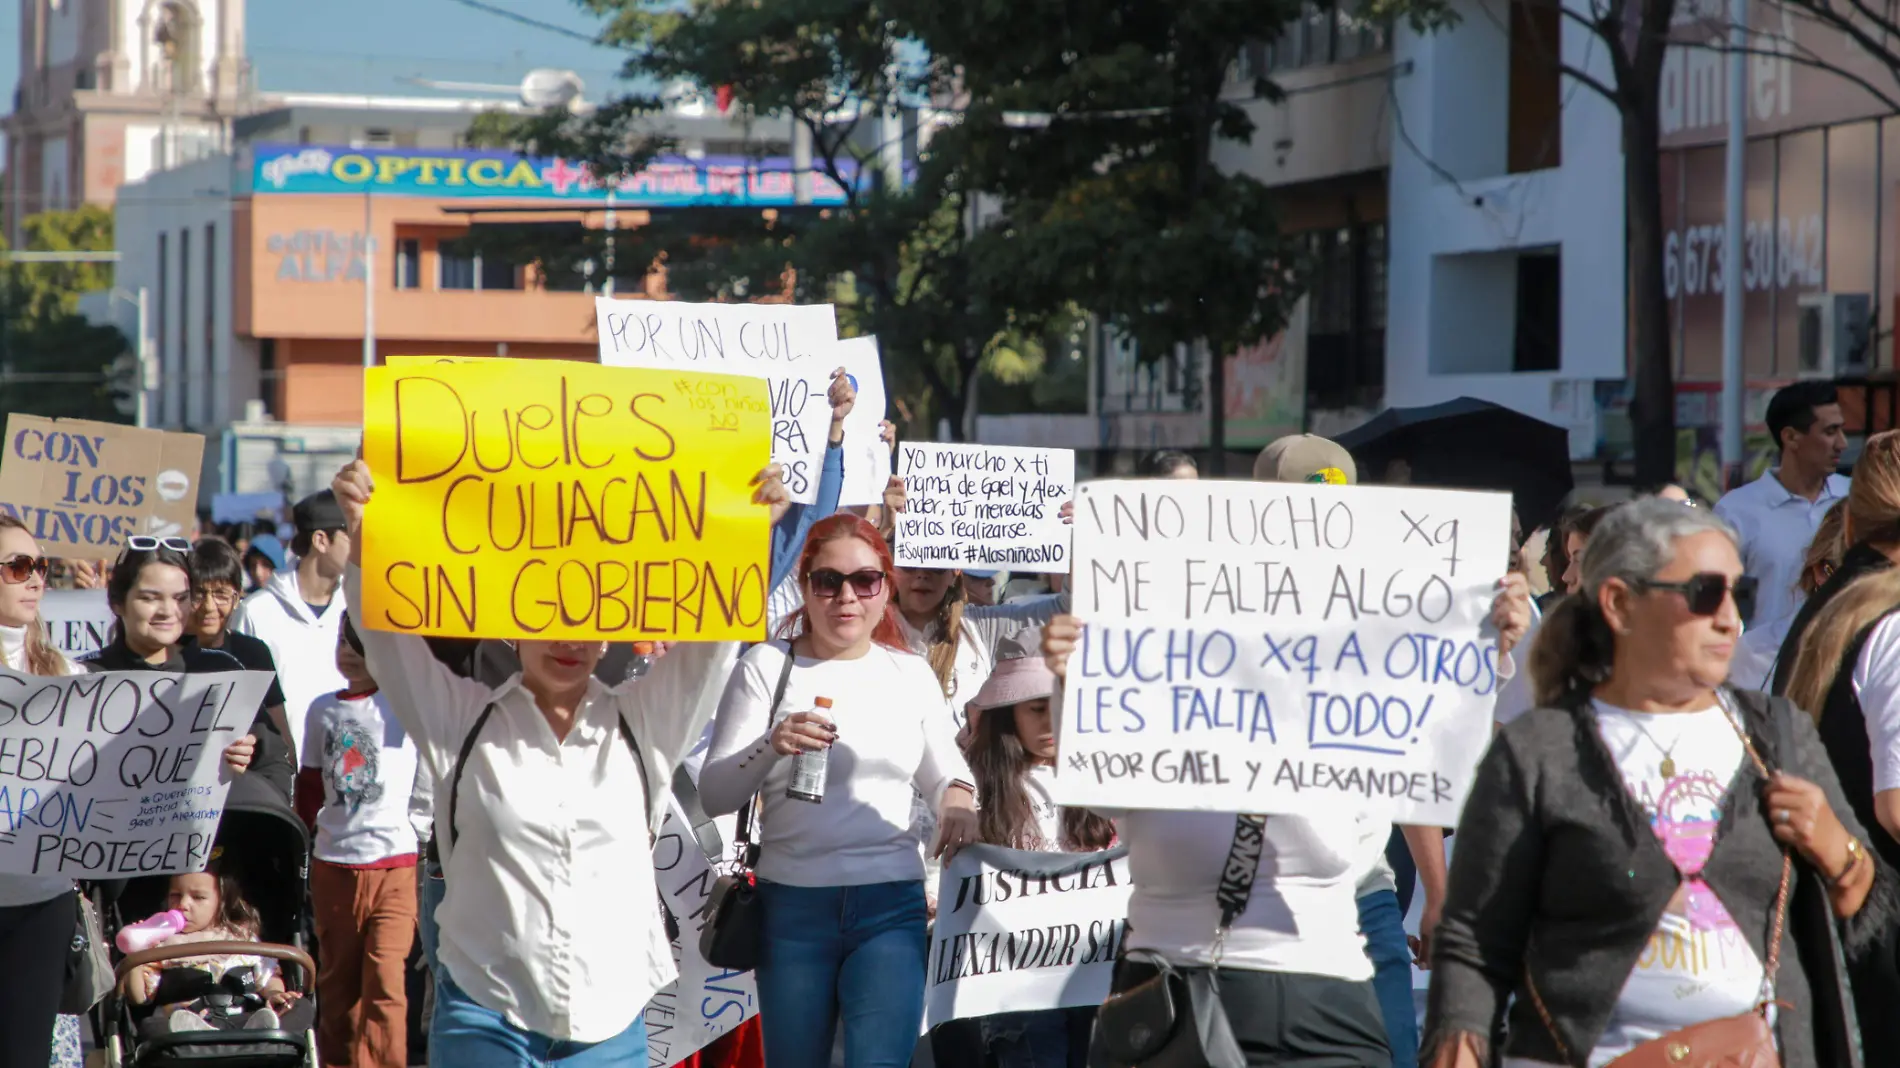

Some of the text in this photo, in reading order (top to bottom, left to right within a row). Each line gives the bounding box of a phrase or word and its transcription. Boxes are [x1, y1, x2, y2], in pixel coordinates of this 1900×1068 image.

[332, 154, 543, 188] OPTICA
[277, 253, 368, 282] ALFA
[608, 313, 811, 361] POR UN CUL.
[395, 375, 676, 484] Dueles
[709, 412, 739, 431] NO
[772, 420, 809, 454] RA
[14, 428, 105, 468] CON
[937, 450, 1006, 473] marcho
[1030, 454, 1048, 475] ti
[62, 470, 146, 507] LOS
[775, 458, 808, 494] OS
[958, 474, 977, 496] de
[442, 470, 706, 554] CULIACAN
[900, 518, 1033, 540] verlos realizarse.
[975, 501, 1046, 520] merecías
[385, 557, 766, 635] SIN GOBIERNO
[1091, 558, 1453, 624] ME FALTA ALGO
[1082, 623, 1237, 683] LUCHO
[1334, 630, 1369, 676] A
[1384, 632, 1498, 696] OTROS
[0, 674, 237, 738] SOMOS EL
[1076, 685, 1435, 748] LES FALTA TODO!
[0, 736, 202, 789] EBLO QUE
[1151, 749, 1231, 785] GAEL
[1273, 758, 1453, 804] ALEXANDER
[32, 833, 211, 874] PROTEGER!
[951, 857, 1119, 913] JUSTICIA
